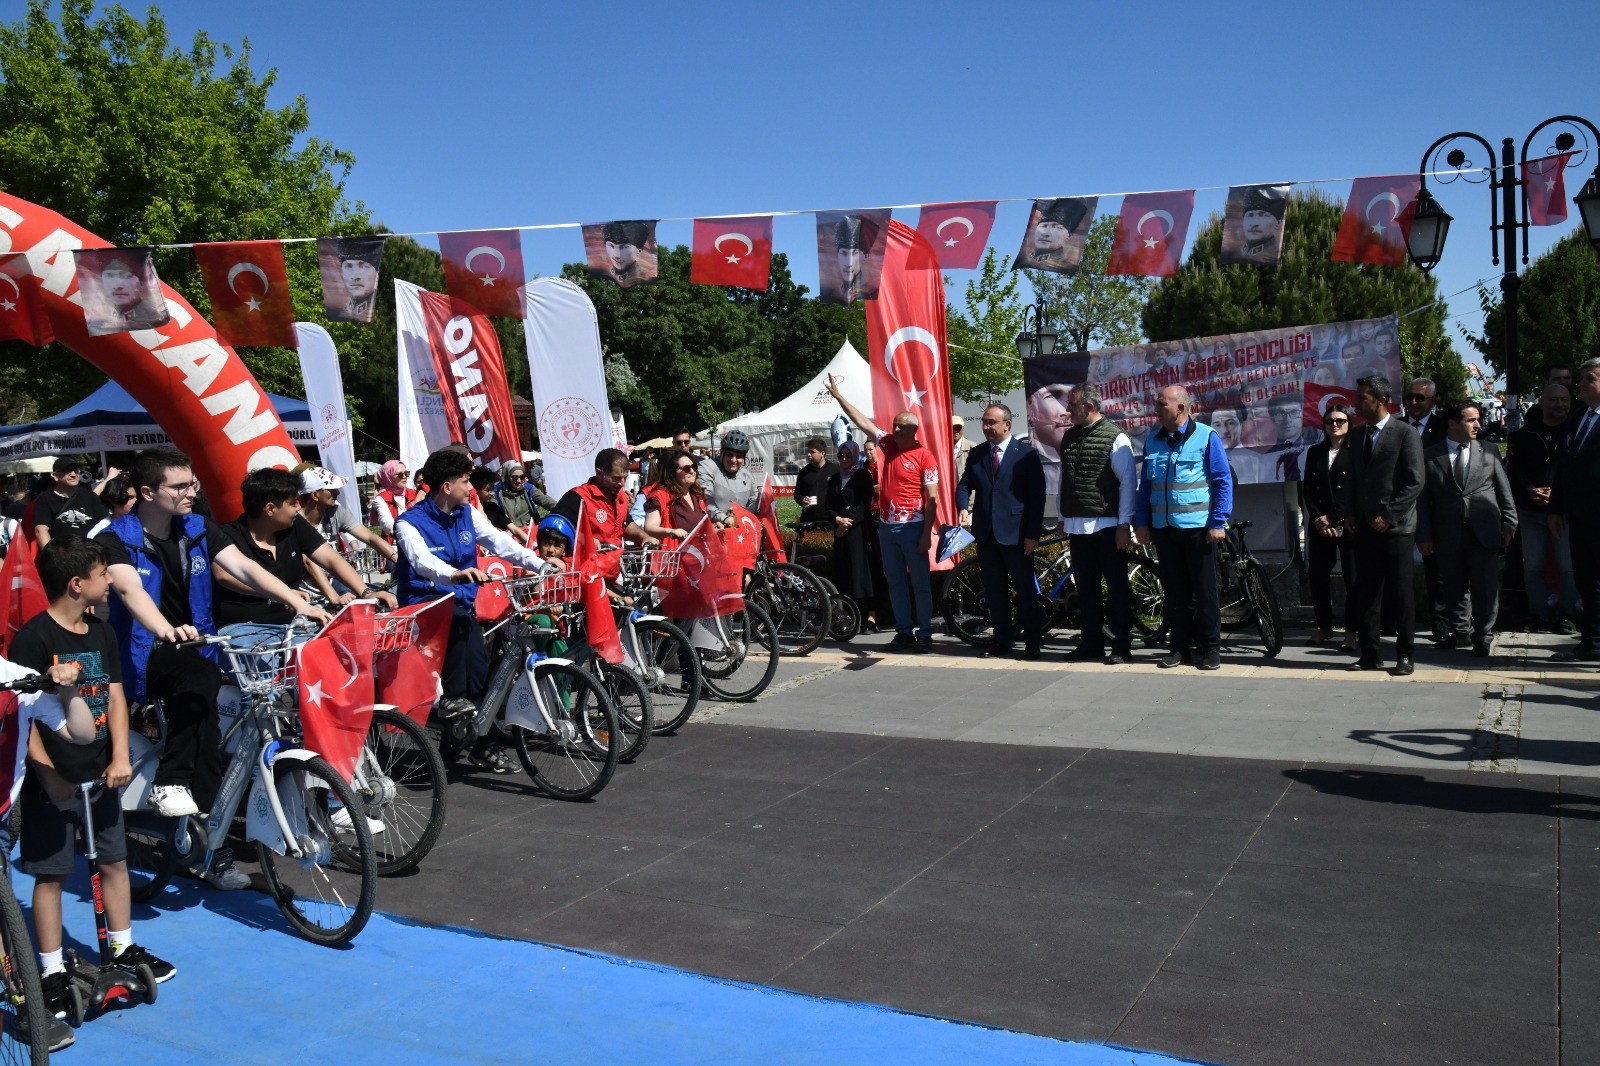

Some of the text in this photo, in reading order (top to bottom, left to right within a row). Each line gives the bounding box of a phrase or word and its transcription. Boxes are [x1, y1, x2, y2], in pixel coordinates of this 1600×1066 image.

[1184, 353, 1229, 381] GÜCÜ
[1235, 331, 1311, 369] GENÇLİĞİ
[1209, 373, 1242, 392] ANMA
[1247, 360, 1298, 383] GENÇLİK
[1302, 355, 1318, 371] VE
[1256, 381, 1301, 401] OLSUN!
[32, 439, 45, 452] SPOR
[125, 430, 173, 446] TEKİRDA
